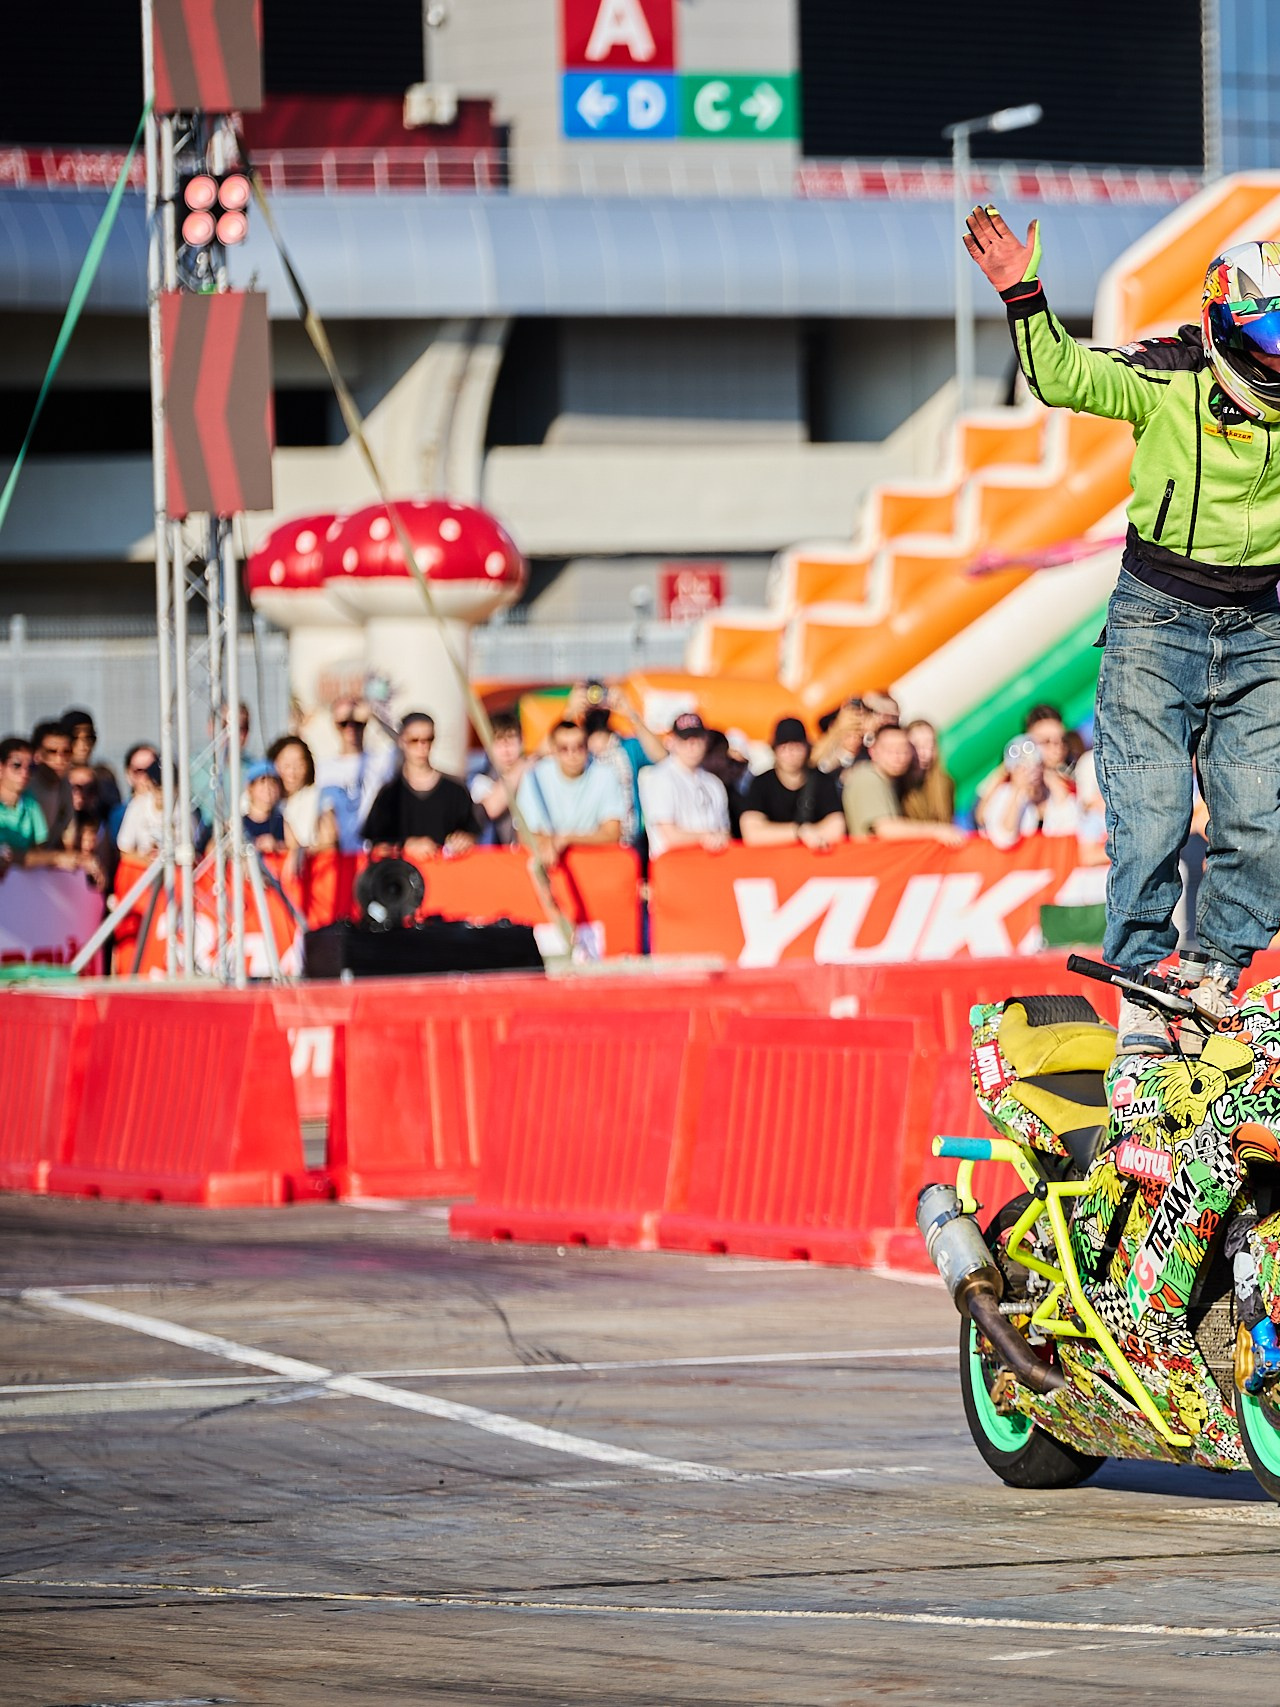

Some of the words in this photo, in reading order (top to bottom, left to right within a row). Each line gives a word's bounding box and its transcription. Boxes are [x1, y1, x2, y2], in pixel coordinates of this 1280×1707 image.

[584, 0, 656, 62] A
[627, 79, 667, 130] D
[693, 80, 731, 132] C
[976, 1044, 1000, 1091] MOTUL
[1114, 1100, 1156, 1121] TEAM
[1120, 1145, 1171, 1182] MOTUL
[1145, 1166, 1199, 1262] TEAM
